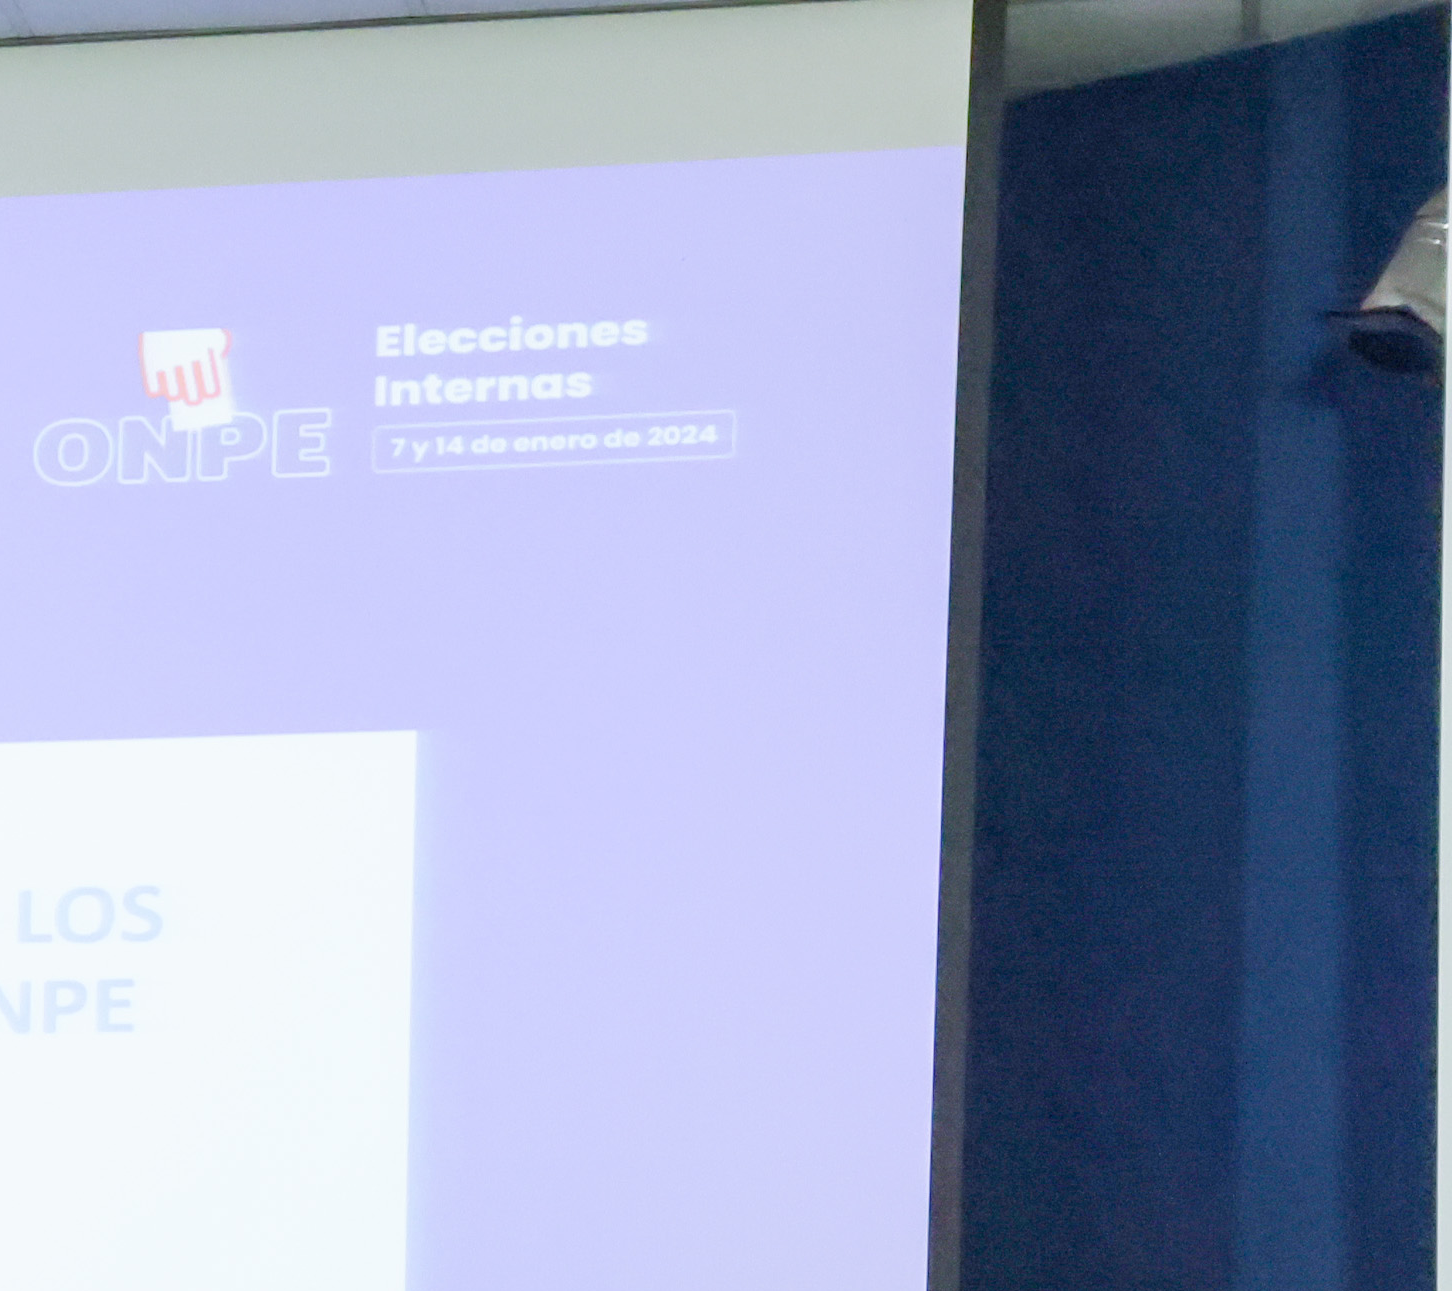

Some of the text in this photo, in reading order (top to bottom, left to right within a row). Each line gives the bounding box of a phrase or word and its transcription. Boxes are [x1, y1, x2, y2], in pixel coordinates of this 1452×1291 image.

[375, 315, 649, 357] Elecciones
[374, 371, 594, 406] Internas
[33, 408, 332, 487] ONPE
[391, 424, 719, 463] 7 y 14 de enero de 2024
[17, 884, 164, 944] LOS
